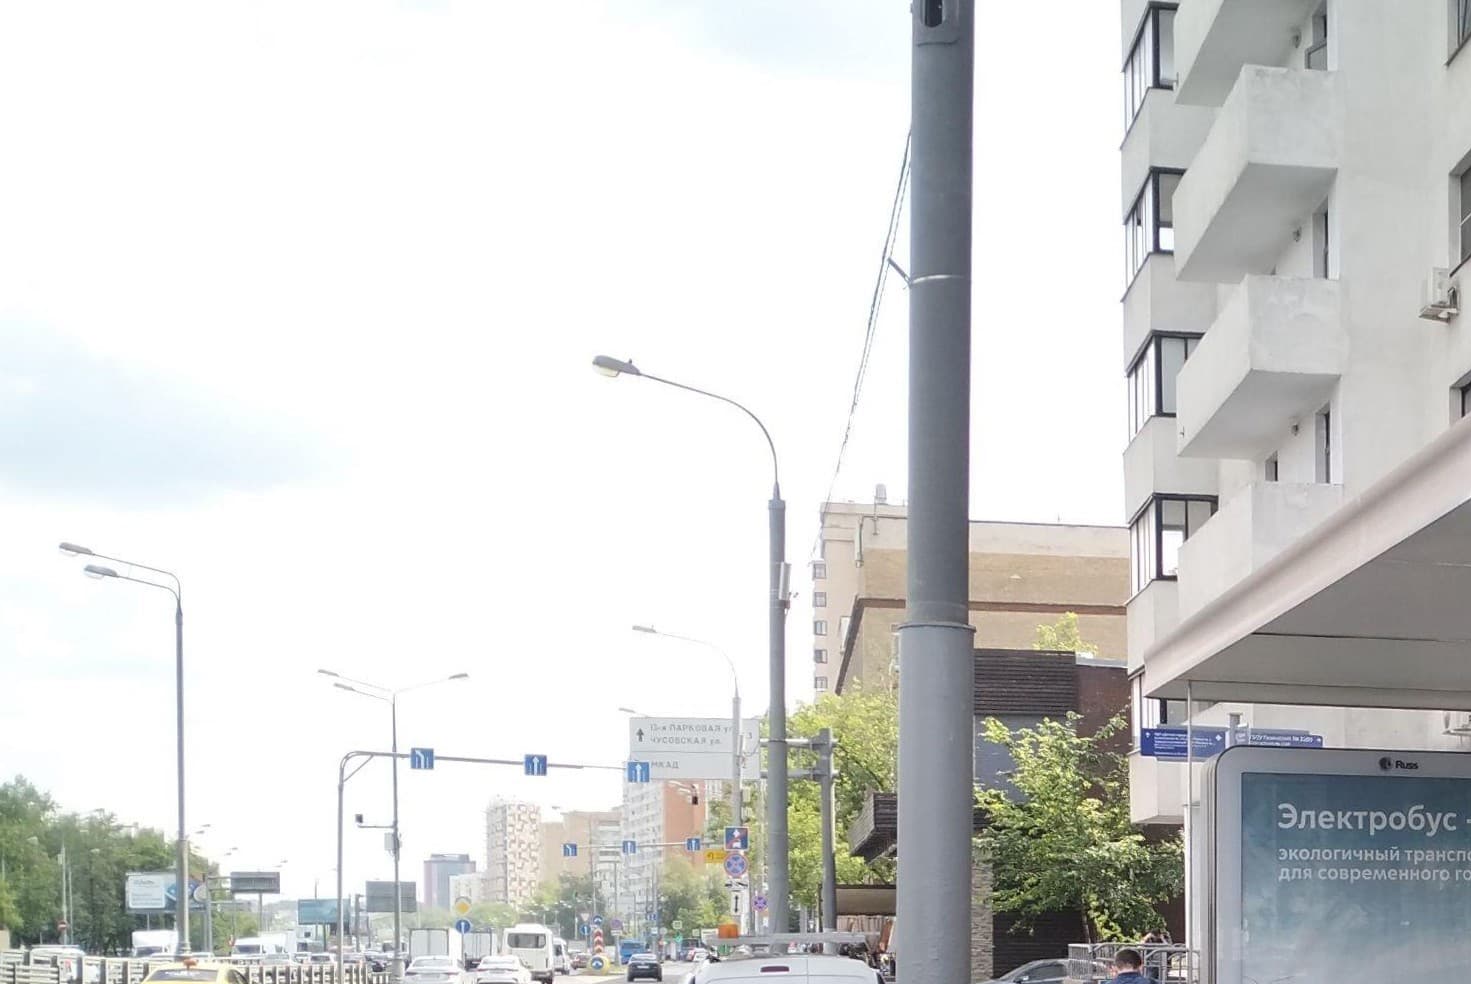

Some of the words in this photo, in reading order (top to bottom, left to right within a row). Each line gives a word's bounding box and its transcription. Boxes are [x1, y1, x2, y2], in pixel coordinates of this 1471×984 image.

[1277, 803, 1457, 837] Электробус
[1278, 846, 1400, 862] экологичный
[1278, 867, 1312, 882] для
[1318, 867, 1450, 883] современного
